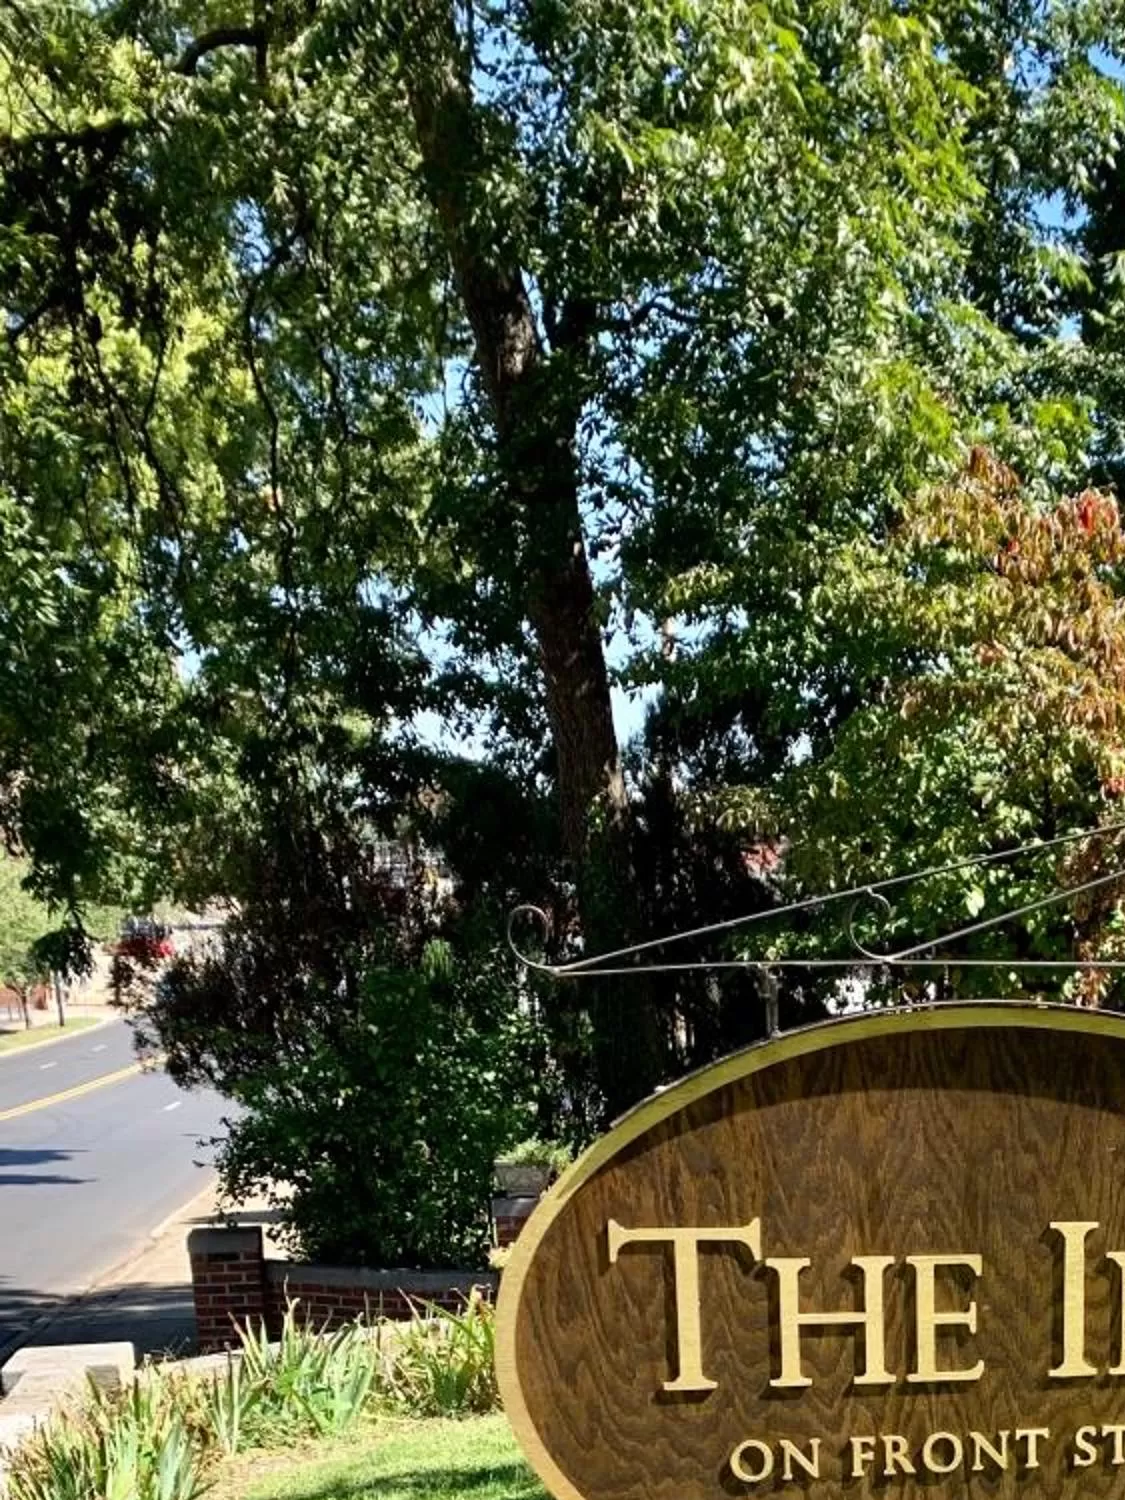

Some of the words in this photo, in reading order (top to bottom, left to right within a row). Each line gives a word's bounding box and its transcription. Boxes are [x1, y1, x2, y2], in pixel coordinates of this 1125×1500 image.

[607, 1217, 985, 1393] THE
[730, 1430, 823, 1482] ON
[850, 1425, 1050, 1478] FRONT
